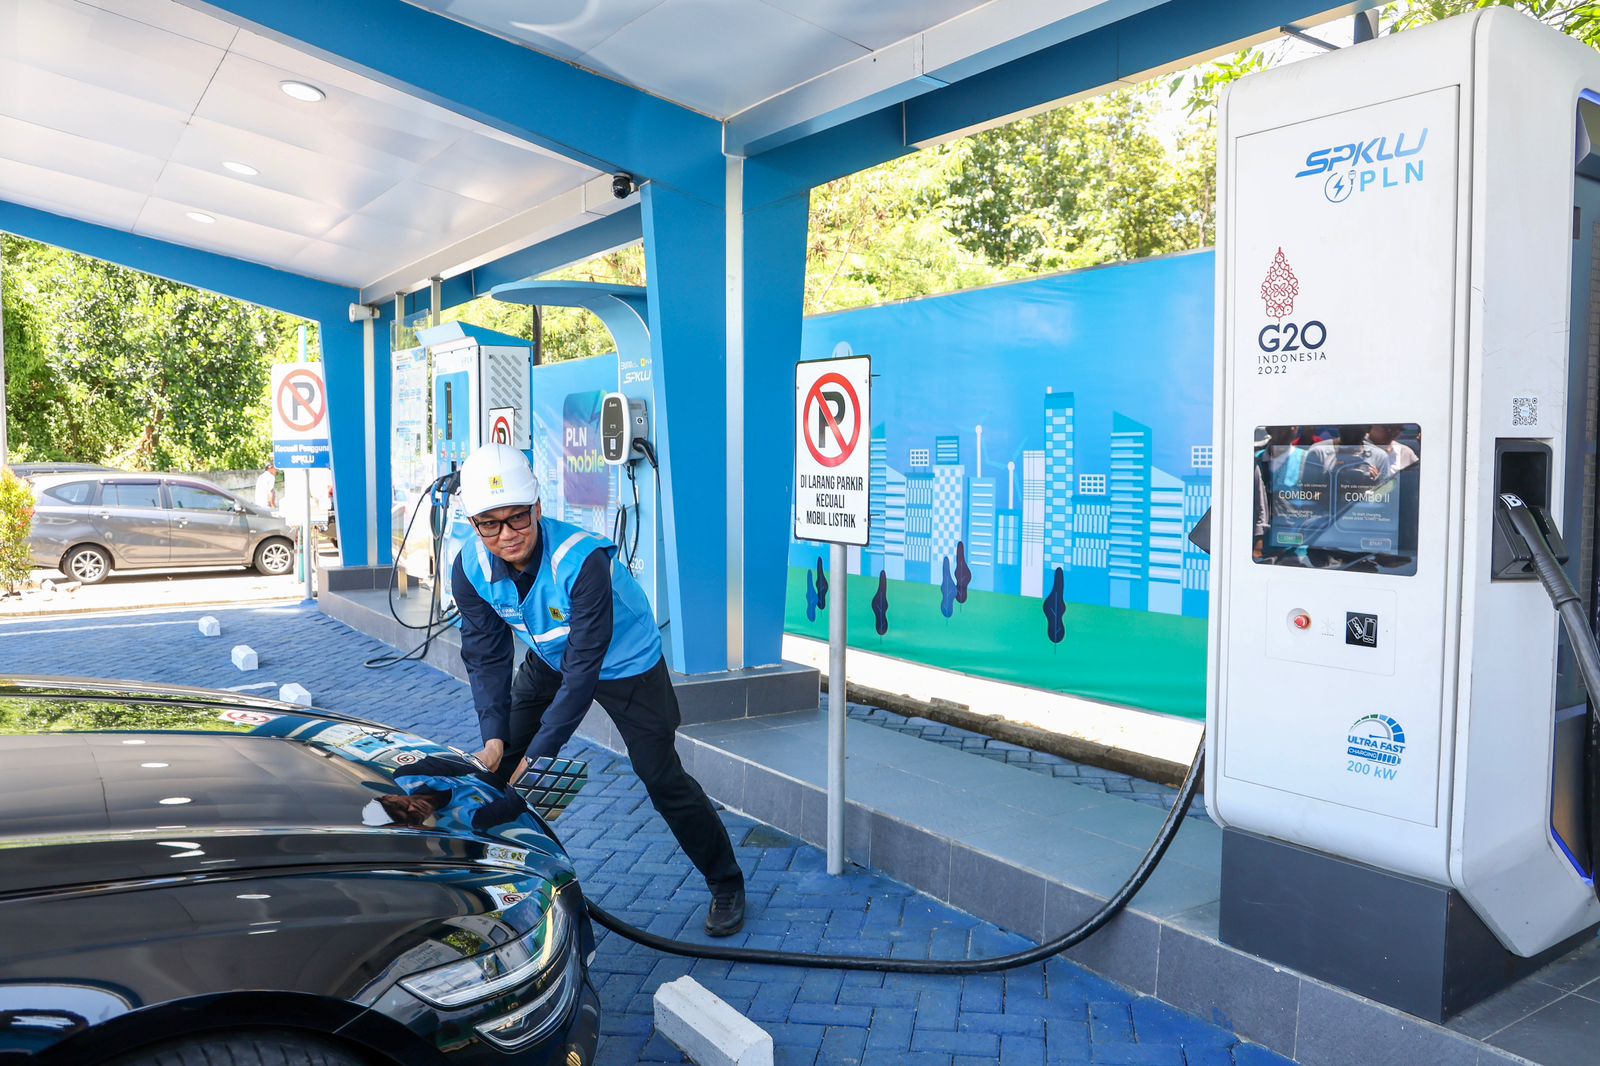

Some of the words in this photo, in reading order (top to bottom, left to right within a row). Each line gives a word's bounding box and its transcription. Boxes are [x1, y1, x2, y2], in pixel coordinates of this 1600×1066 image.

[1295, 128, 1428, 178] SPKLU
[1360, 160, 1424, 192] PLN
[1258, 320, 1327, 353] G20
[1258, 352, 1327, 364] INDONESIA
[623, 370, 651, 384] SPKLU
[1258, 365, 1287, 375] 2022
[566, 427, 587, 447] PLN
[290, 455, 315, 464] SPKLU
[566, 449, 605, 473] mobile
[800, 474, 807, 488] DI
[808, 475, 835, 489] LARANG
[836, 476, 864, 491] PARKIR
[816, 493, 845, 509] KECUALI
[1278, 490, 1313, 501] COMBO
[1344, 492, 1382, 503] COMBO
[1502, 494, 1522, 507] B
[806, 510, 827, 526] MOBIL
[829, 512, 856, 528] LISTRIK
[1347, 734, 1378, 748] ULTRA
[1380, 741, 1406, 753] FAST
[1348, 747, 1377, 759] CHARGING
[1346, 760, 1370, 775] 200
[1374, 766, 1397, 781] kW
